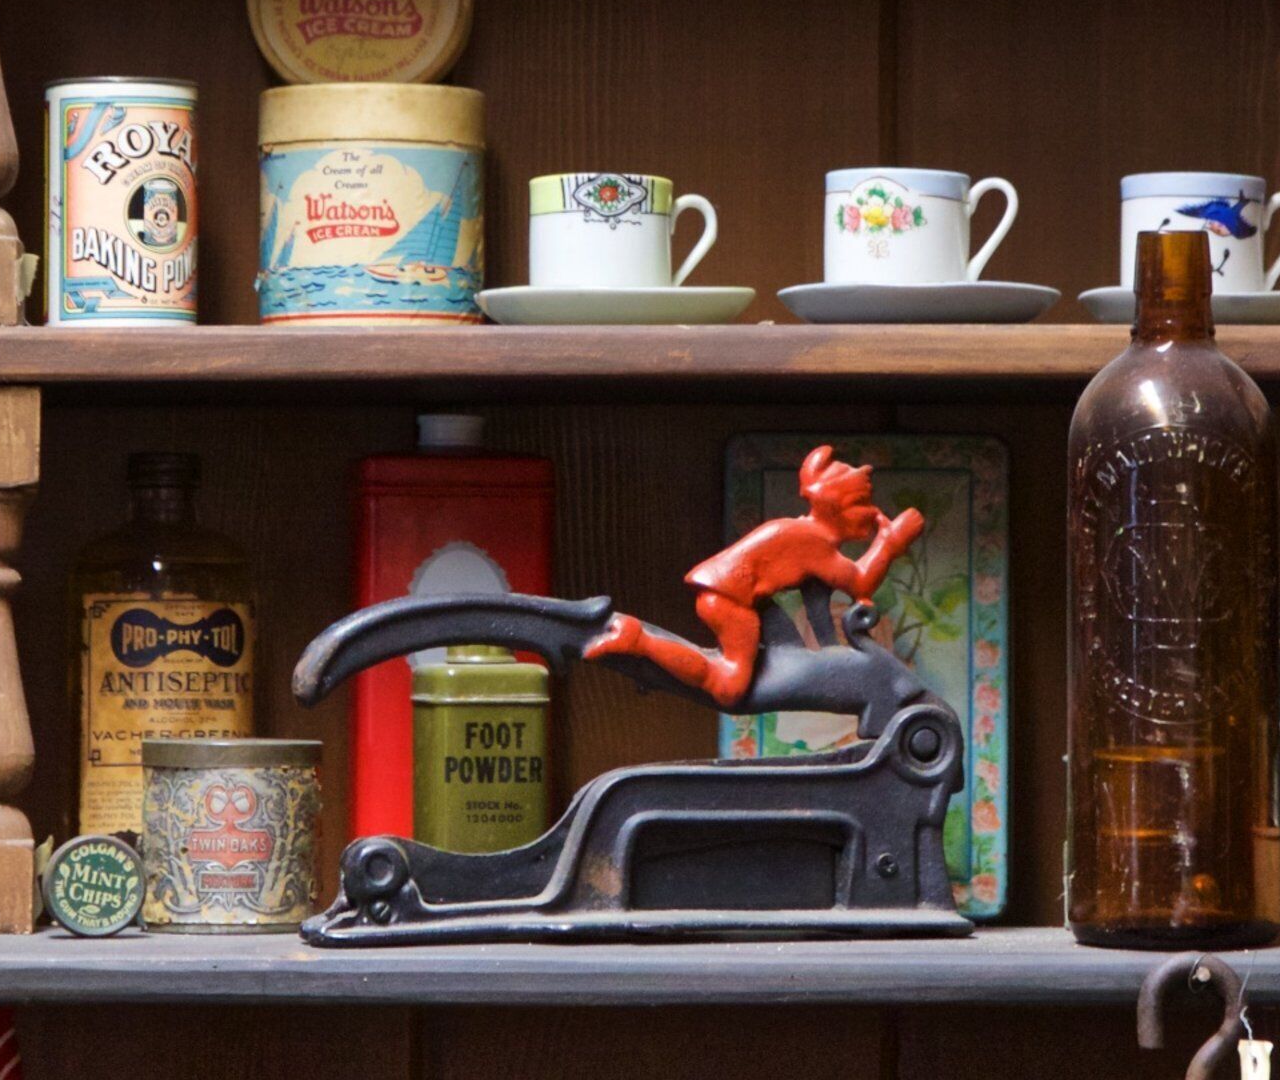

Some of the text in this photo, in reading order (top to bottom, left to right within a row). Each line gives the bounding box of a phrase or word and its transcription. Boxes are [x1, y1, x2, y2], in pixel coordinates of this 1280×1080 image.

[306, 20, 413, 39] ICE CREAM
[82, 120, 197, 187] ROYA
[342, 151, 360, 162] The
[322, 164, 384, 178] Cream of all
[334, 180, 368, 190] Creams
[304, 192, 397, 223] Watson's
[312, 226, 381, 241] ICE CREAM
[71, 226, 197, 295] BAKING POW
[122, 622, 240, 656] PRO-PHY-TOL
[100, 671, 250, 694] ANTISEPTIC
[123, 698, 148, 710] AND
[153, 698, 200, 710] MOUTH
[465, 722, 527, 750] FOOT
[444, 756, 544, 784] POWDER
[466, 801, 500, 810] STOCK
[70, 842, 136, 872] COLGAN'S
[191, 837, 267, 853] TWIN OAKS
[71, 862, 127, 889] MINT
[69, 882, 122, 909] CHIPS
